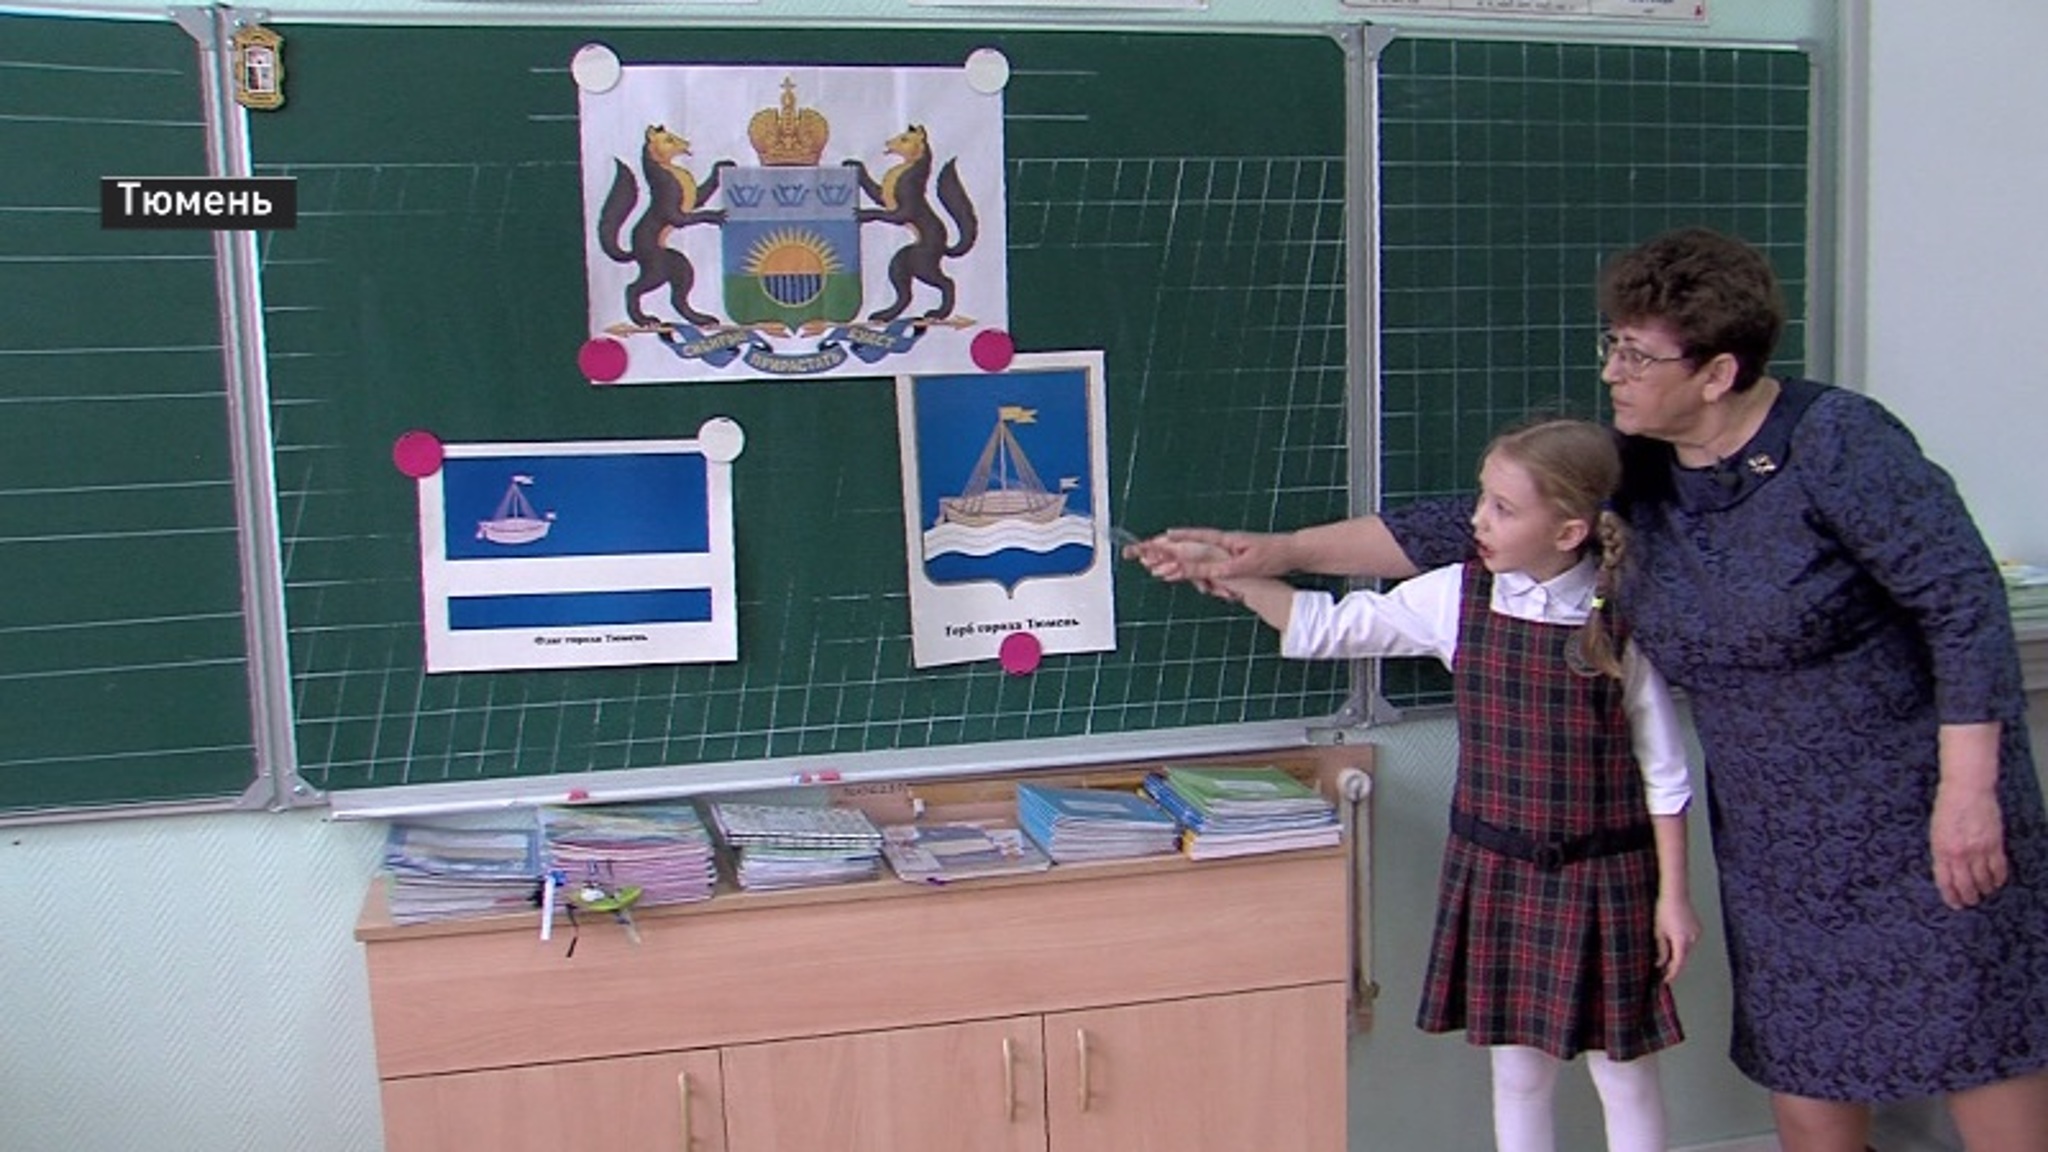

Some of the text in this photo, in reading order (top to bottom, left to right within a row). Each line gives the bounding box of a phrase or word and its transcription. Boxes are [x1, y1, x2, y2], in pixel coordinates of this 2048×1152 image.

[945, 617, 1080, 637] Герб города Тюмень
[565, 636, 602, 646] города
[605, 633, 648, 643] Тюмень
